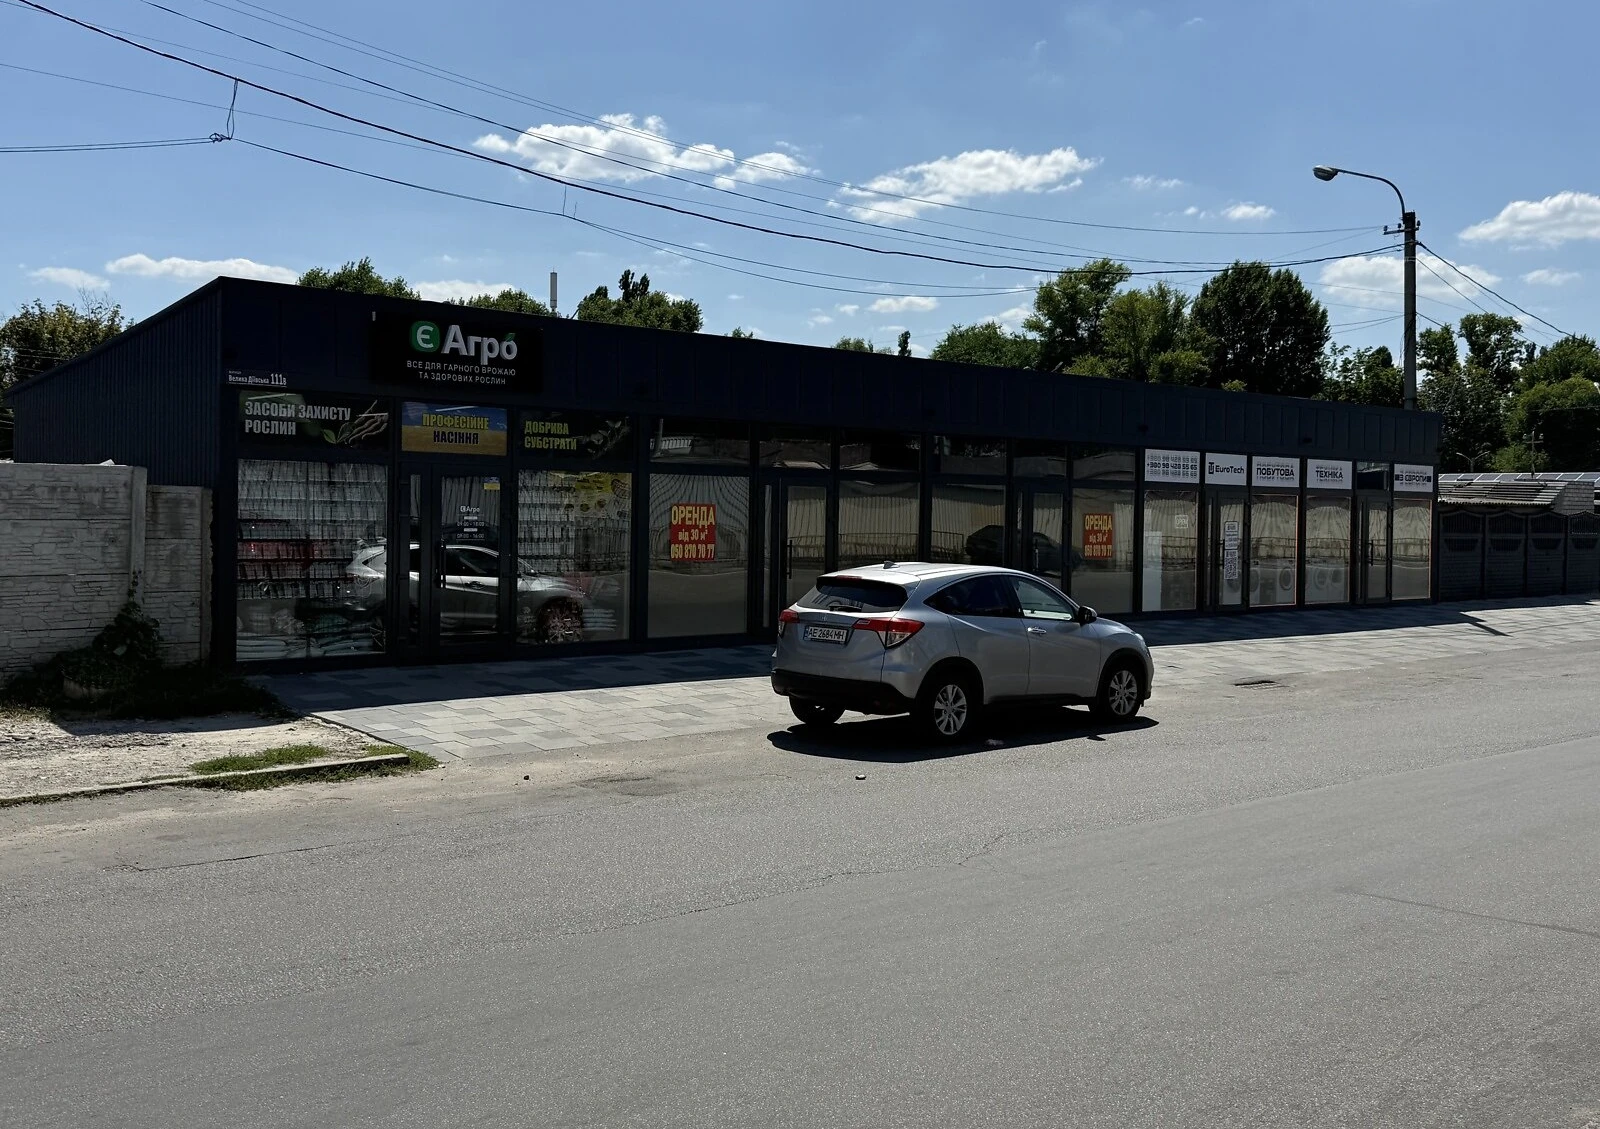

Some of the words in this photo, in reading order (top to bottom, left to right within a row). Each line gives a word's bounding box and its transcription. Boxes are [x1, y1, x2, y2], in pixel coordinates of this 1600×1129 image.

[406, 360, 423, 369] ВСЕ
[425, 361, 442, 371] ДЛЯ
[443, 363, 480, 374] ГАРНОГО
[481, 366, 516, 376] ВРОЖАЮ
[228, 375, 248, 383] Велика
[419, 371, 429, 380] ТА
[431, 372, 474, 383] ЗДОРОВИХ
[475, 375, 506, 385] РОСЛИН
[245, 401, 296, 418] ЗАСОБИ
[298, 404, 351, 421] ЗАХИСТУ
[245, 419, 297, 436] РОСЛИН
[422, 413, 490, 431] ПРОФЕСІЙНЕ
[524, 420, 570, 436] ДОБРИВА
[433, 430, 480, 445] НАСІННЯ
[524, 437, 577, 451] СУБСТРАТИ
[1215, 466, 1244, 474] EuroTech
[1256, 468, 1294, 477] ПОБУТОВА
[1315, 470, 1344, 479] ТЕХНІКА
[672, 505, 715, 528] ОРЕНДА
[1085, 515, 1112, 533] ОРЕНДА
[679, 529, 689, 542] від
[691, 529, 699, 540] 30
[671, 544, 683, 559] 050
[684, 544, 697, 559] 870
[698, 544, 705, 559] 70
[707, 544, 715, 559] 77
[808, 628, 818, 637] AE
[818, 629, 834, 639] 2684
[834, 630, 844, 640] MH
